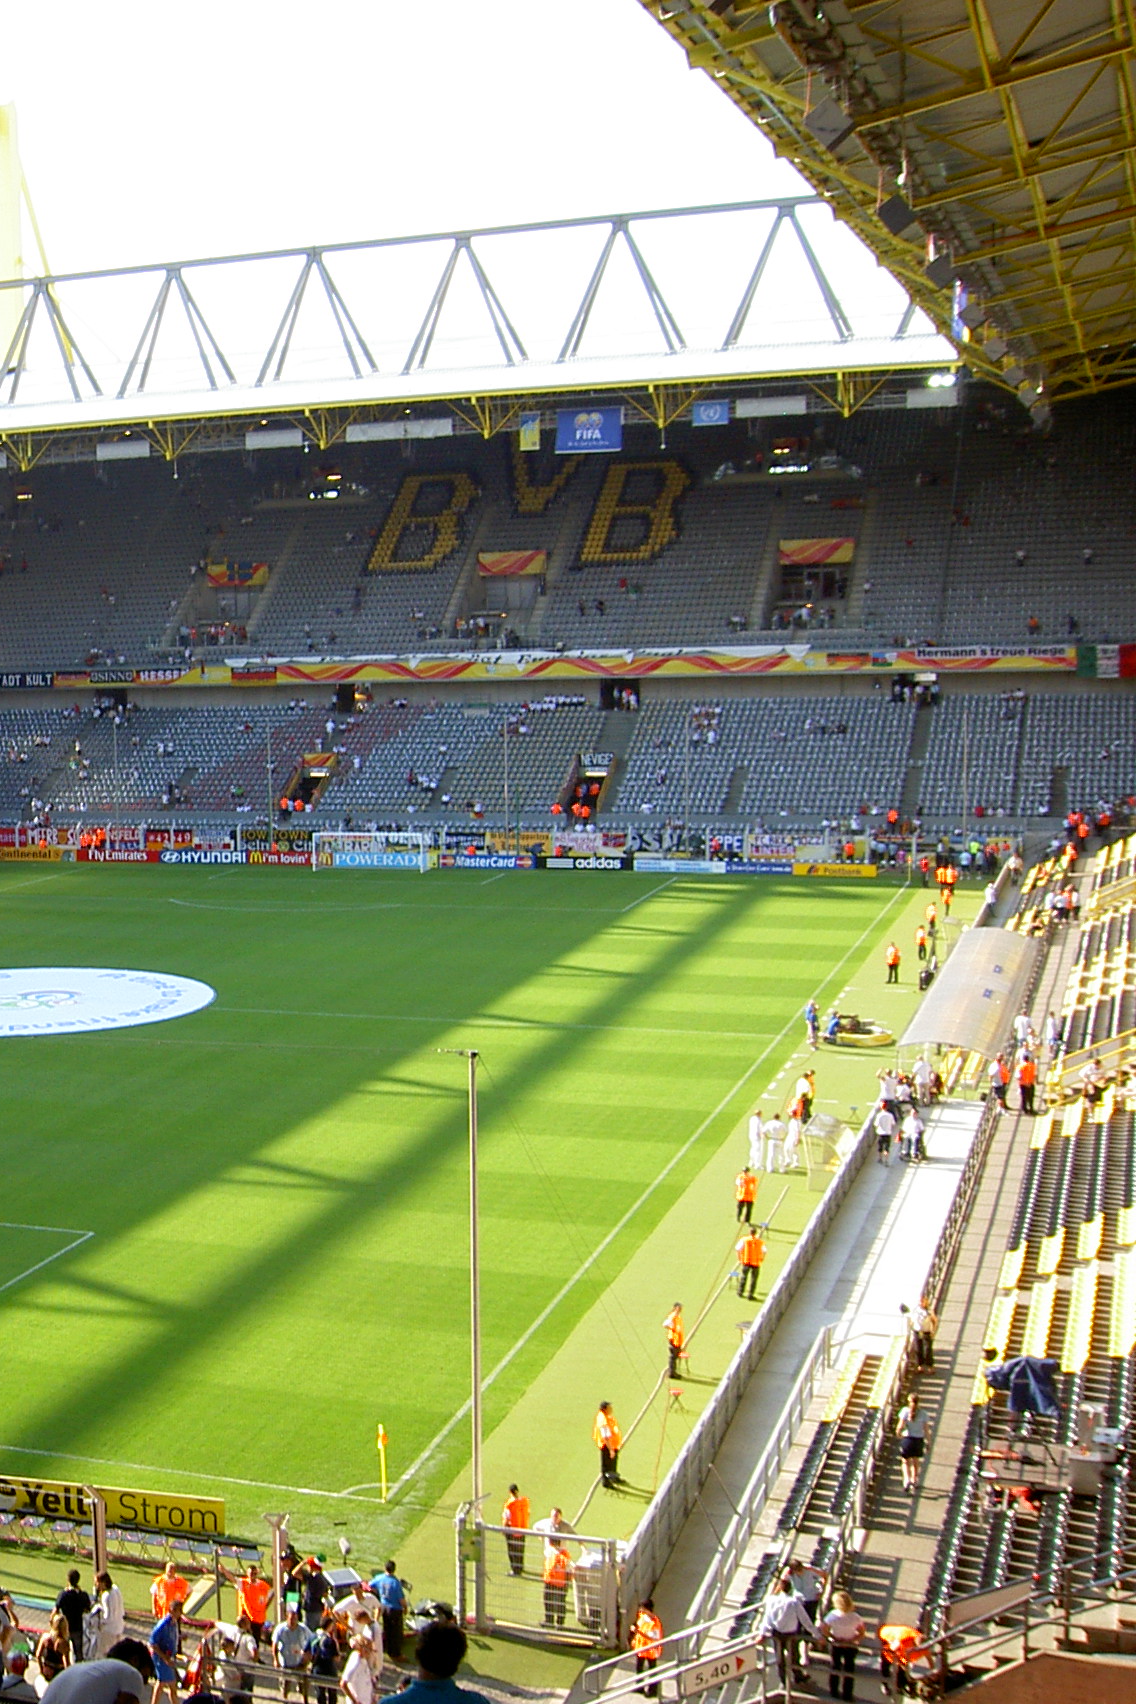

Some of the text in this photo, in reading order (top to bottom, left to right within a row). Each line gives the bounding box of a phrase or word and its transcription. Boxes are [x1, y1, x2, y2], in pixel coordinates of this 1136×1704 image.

[575, 428, 602, 440] FIFA
[26, 674, 52, 686] KULT
[88, 849, 148, 862] Fly Emirates
[181, 851, 247, 864] HYUNDAI
[455, 856, 516, 868] MasterCard
[575, 858, 621, 869] adidas
[22, 1482, 218, 1532] Yell Strom
